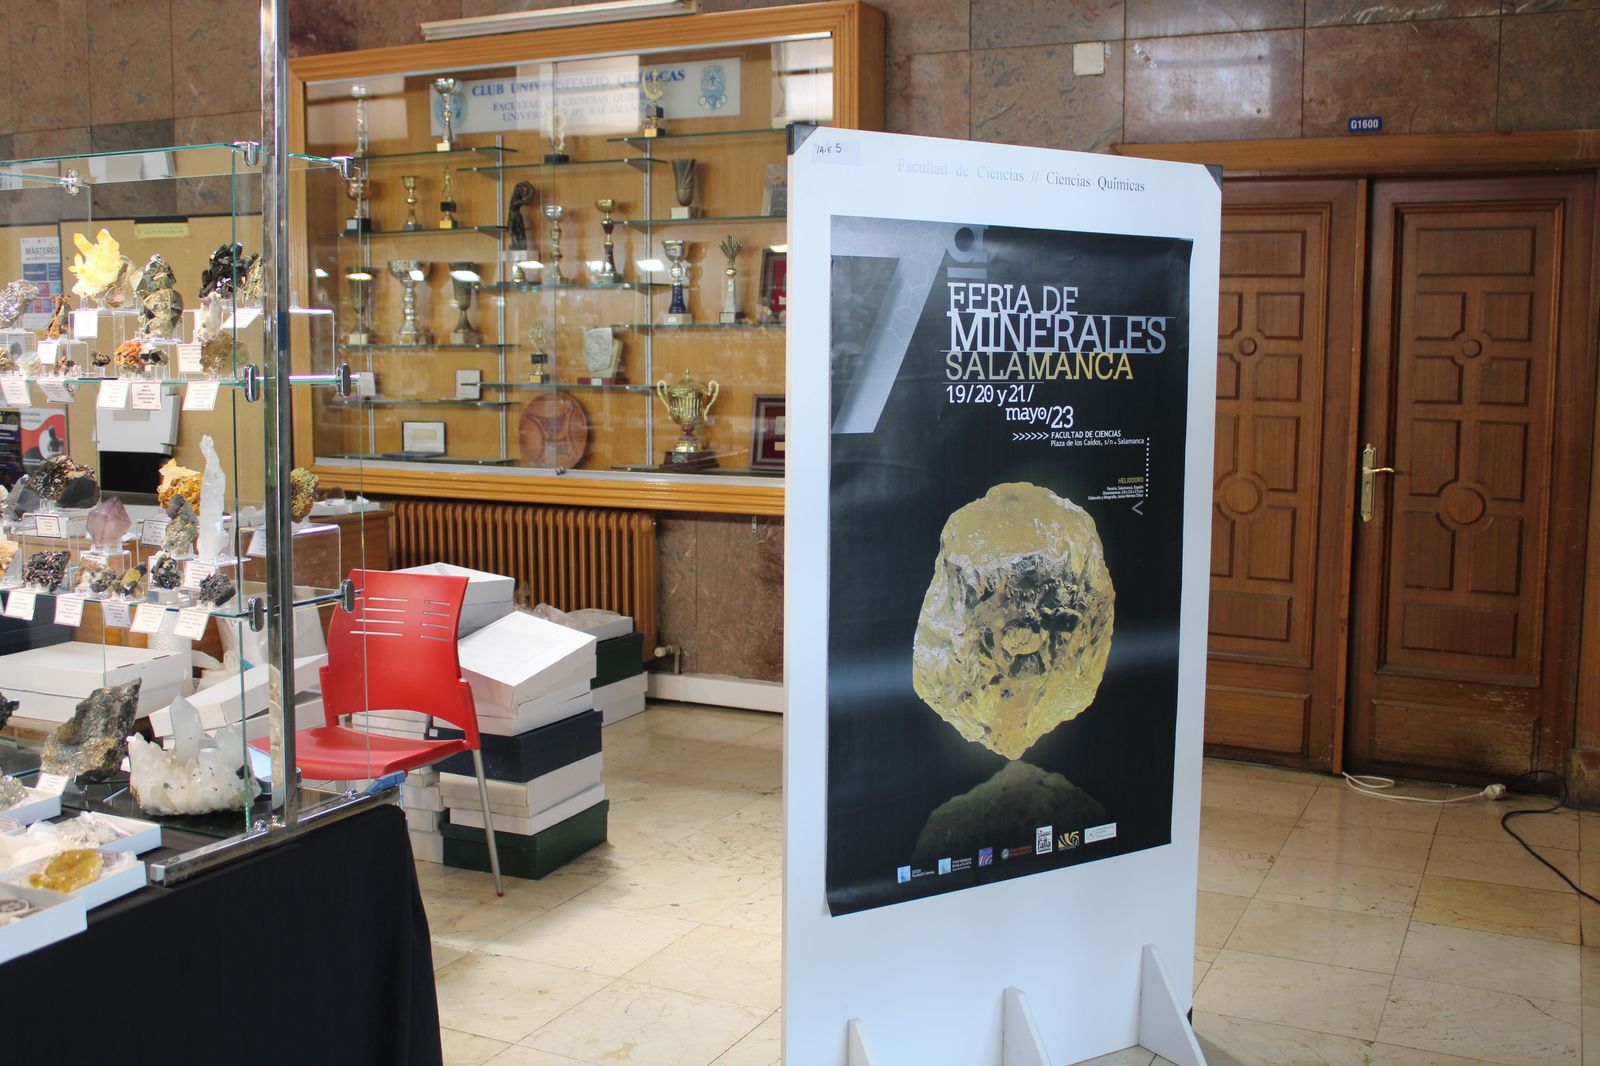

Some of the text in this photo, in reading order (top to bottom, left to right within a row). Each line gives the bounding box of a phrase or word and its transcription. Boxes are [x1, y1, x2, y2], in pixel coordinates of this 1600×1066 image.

[471, 83, 505, 97] CLUB
[1351, 118, 1379, 129] G1600
[897, 157, 949, 177] Facultad
[955, 166, 969, 178] de
[976, 166, 1025, 183] Ciencias
[1046, 171, 1091, 188] Ciencias
[1097, 176, 1146, 193] Químicas
[947, 281, 1079, 315] FERIA DE
[946, 311, 1167, 354] MINERALES
[945, 350, 1134, 380] SALAMANCA
[946, 384, 994, 403] 19/20
[997, 388, 1008, 407] y
[1050, 439, 1065, 447] Plaza
[1066, 439, 1073, 447] de
[1117, 437, 1145, 445] Salamanca
[1051, 429, 1122, 439] FACULTAD DE CIENCIAS
